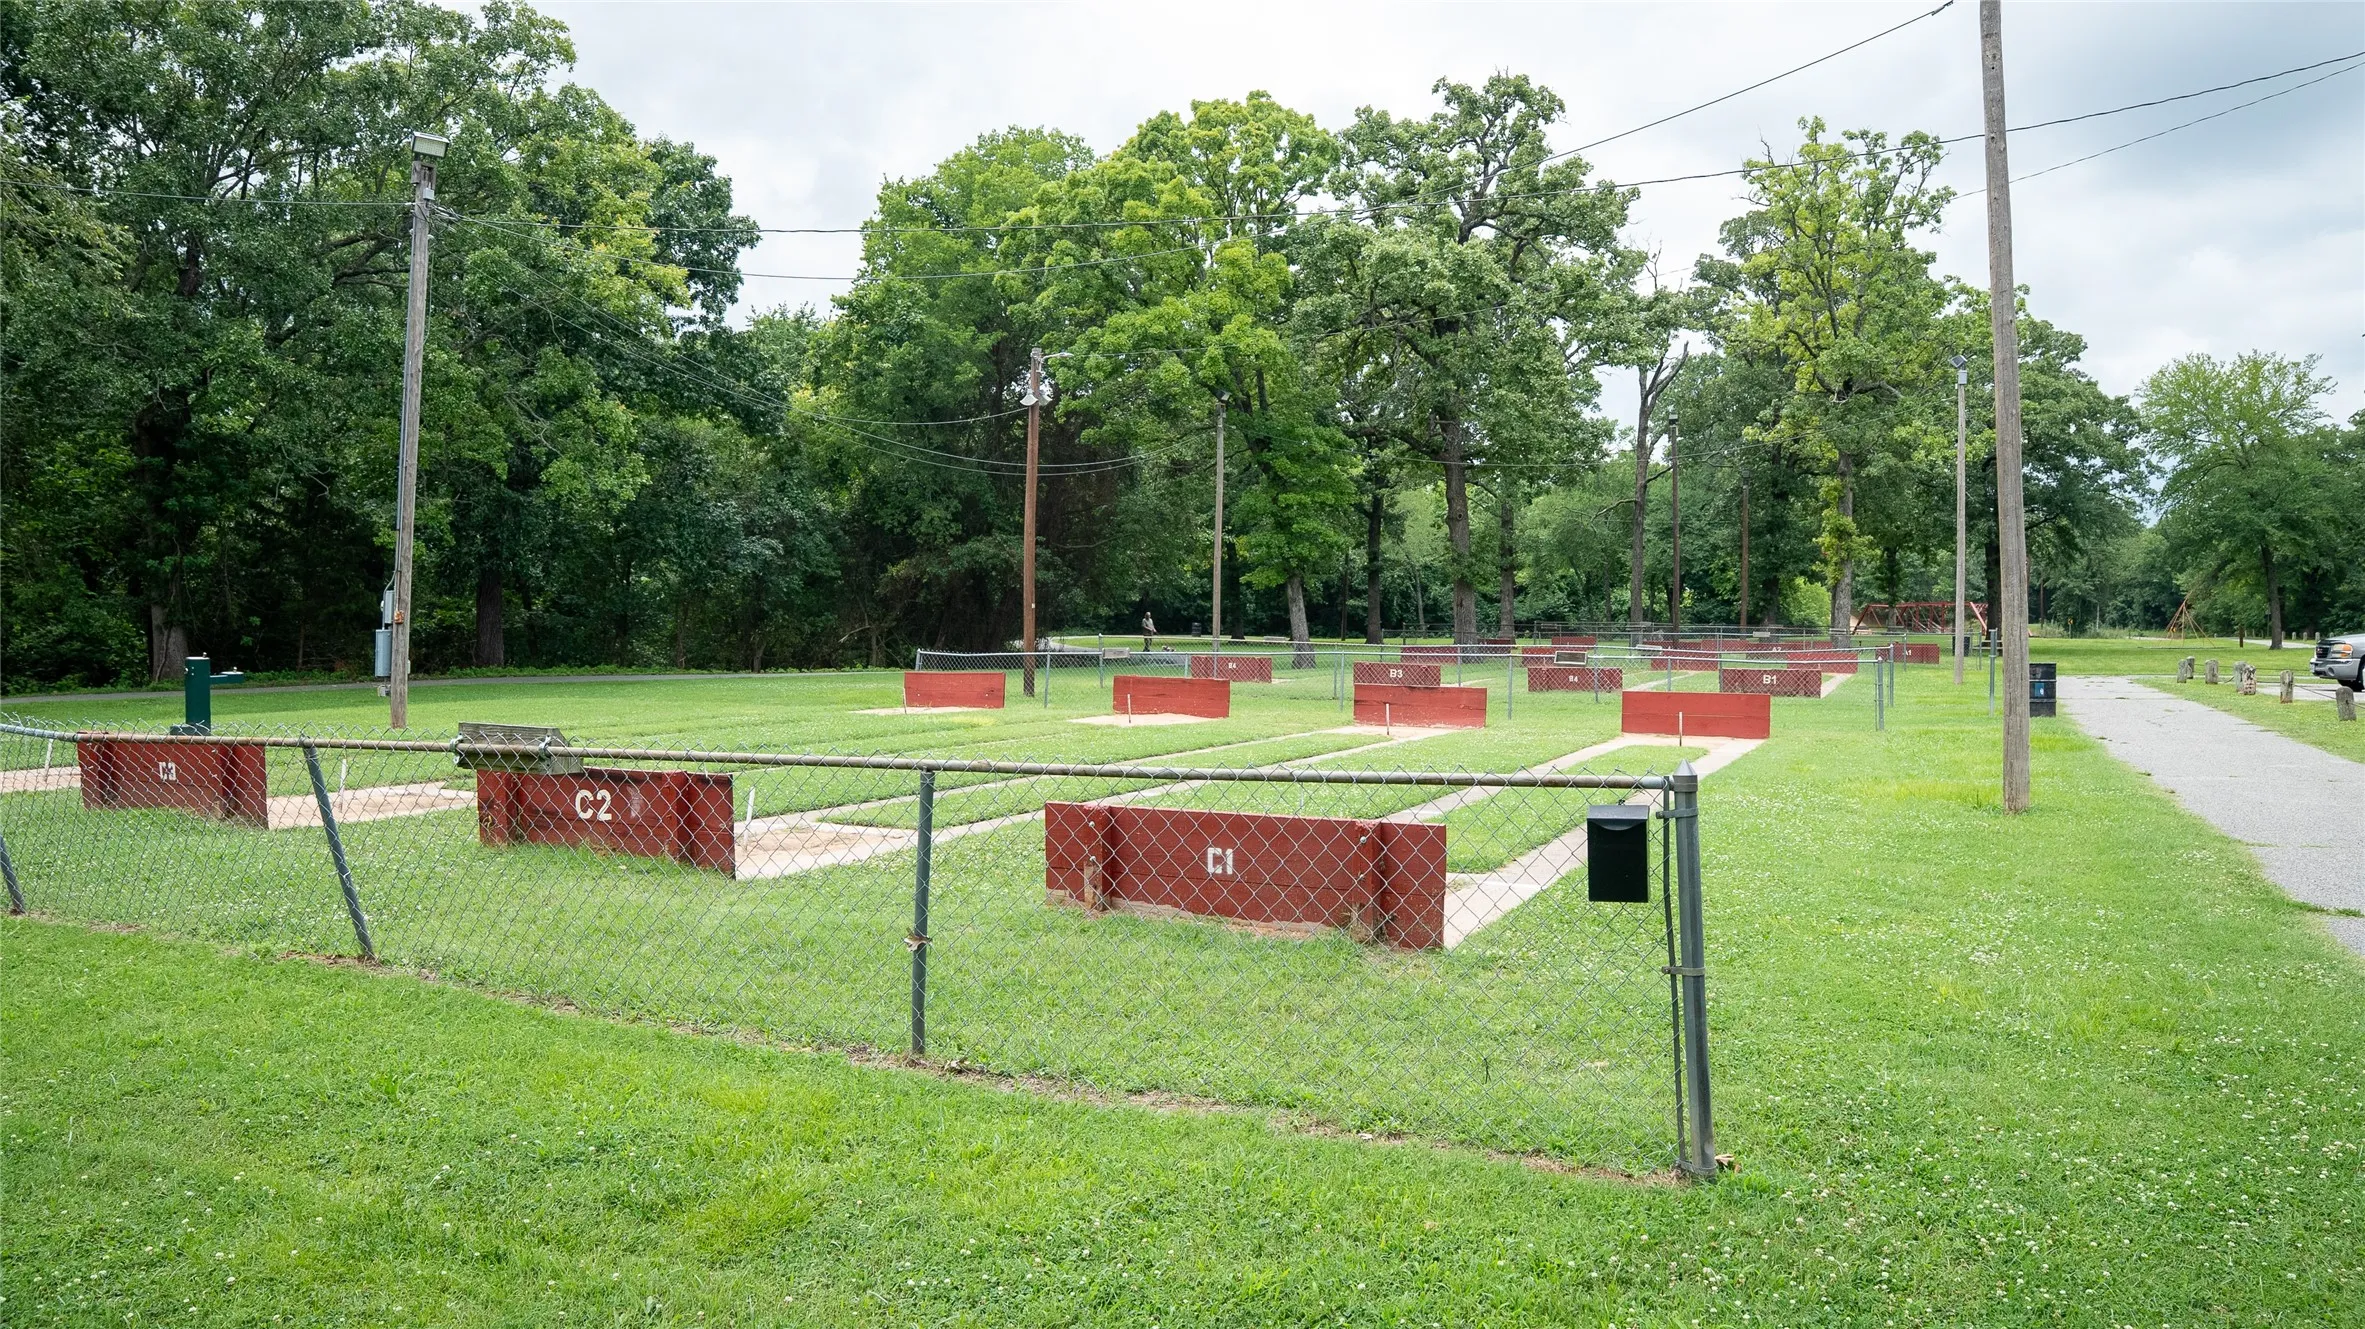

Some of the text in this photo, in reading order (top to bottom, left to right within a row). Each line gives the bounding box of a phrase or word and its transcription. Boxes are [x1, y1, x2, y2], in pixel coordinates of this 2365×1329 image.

[1390, 669, 1403, 678] B3
[1763, 674, 1776, 685] B1
[575, 789, 612, 820] C2
[1207, 847, 1233, 875] C1
